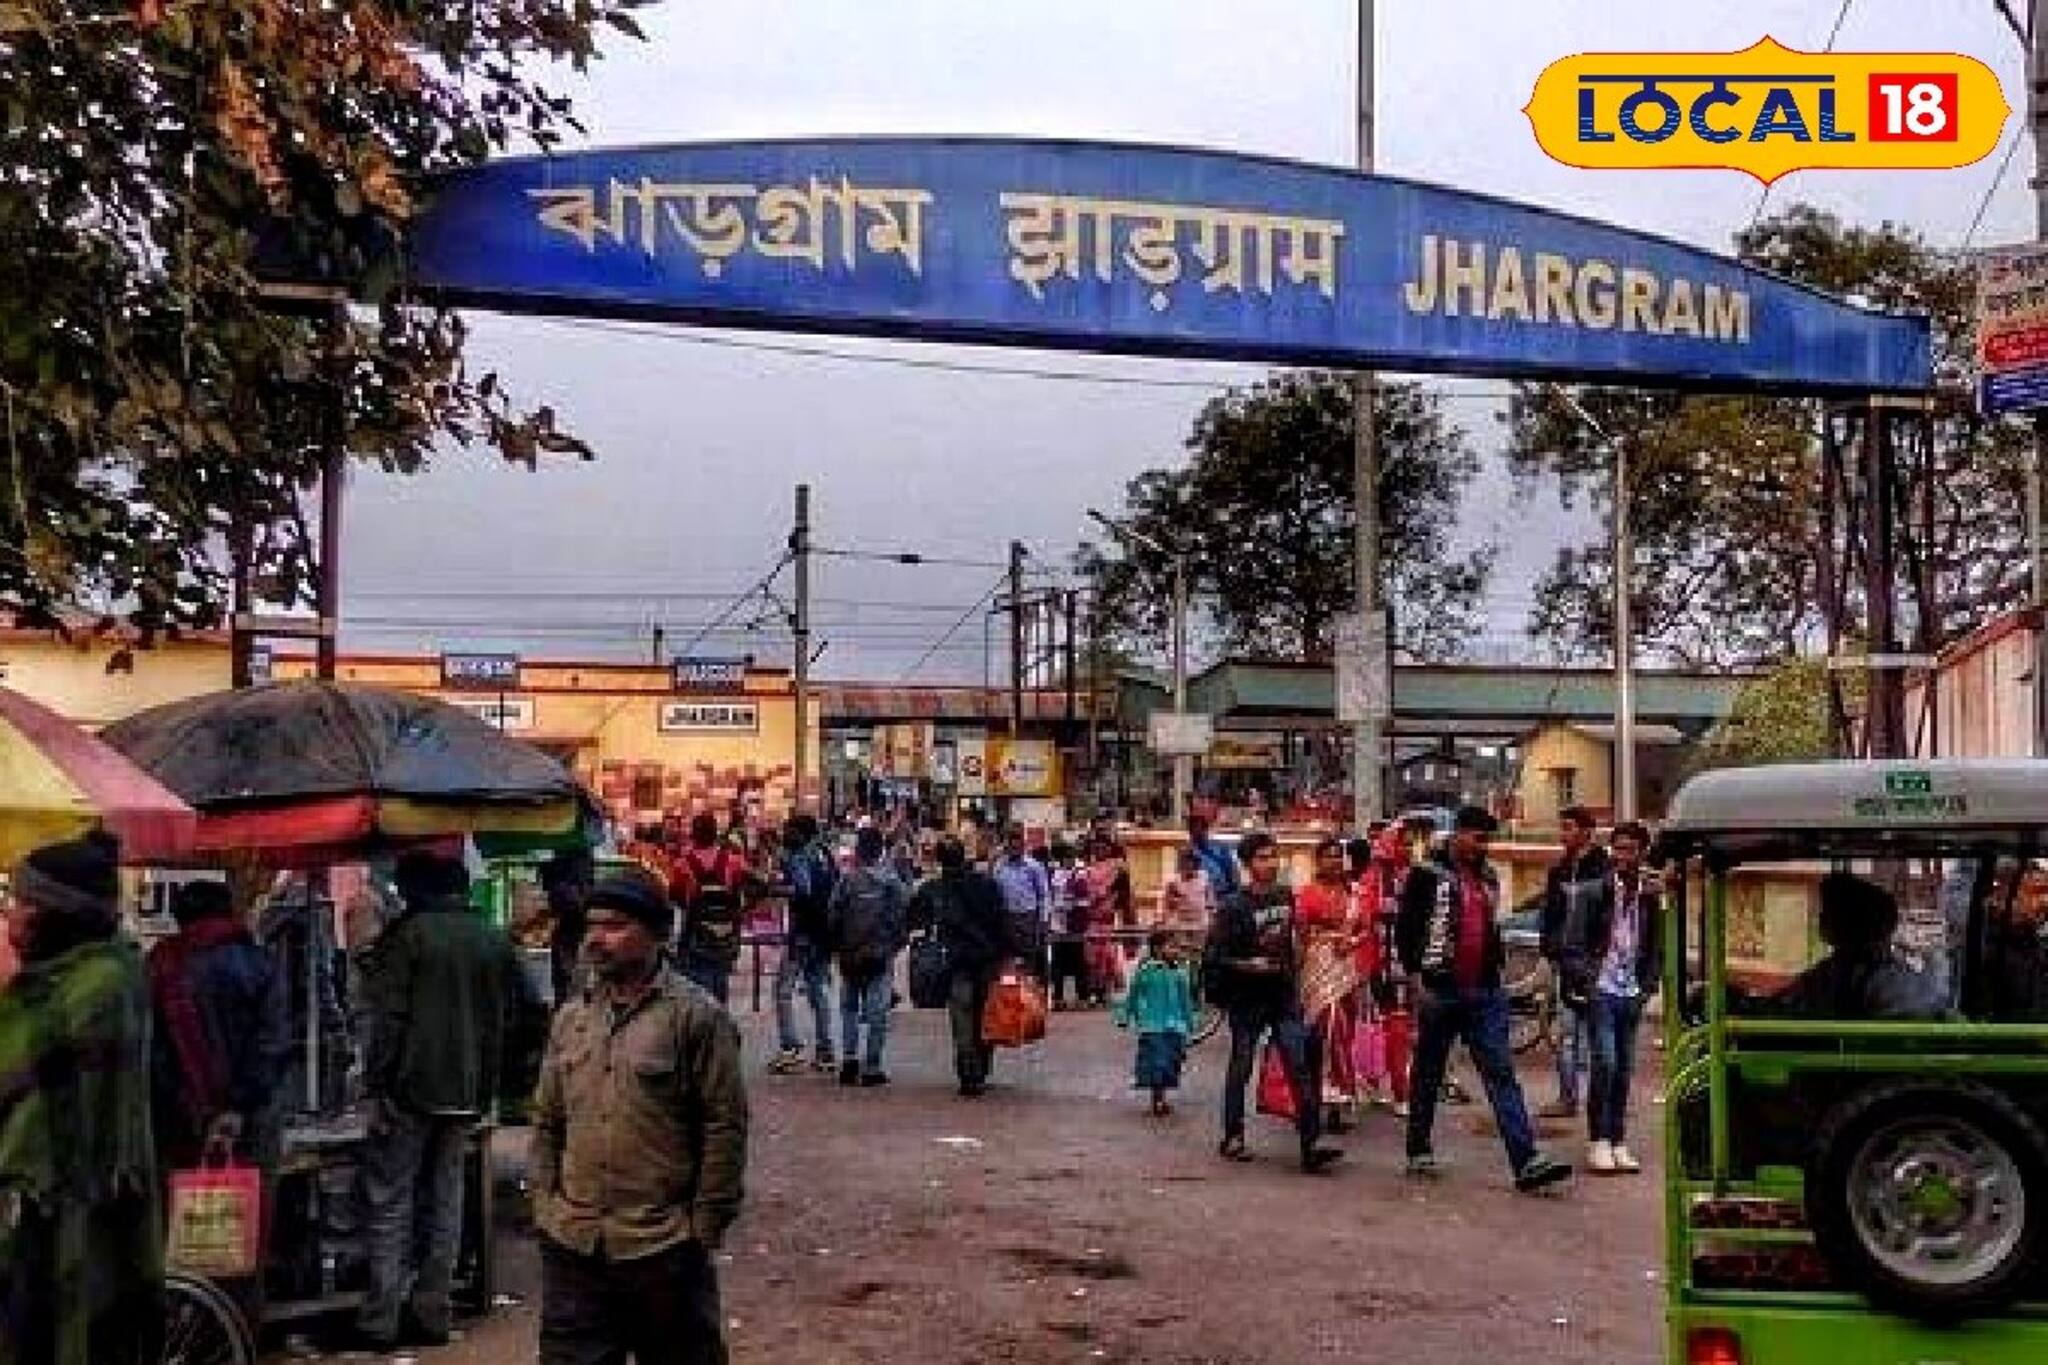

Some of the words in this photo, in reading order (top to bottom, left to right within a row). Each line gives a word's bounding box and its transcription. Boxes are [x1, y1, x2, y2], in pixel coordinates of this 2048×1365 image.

[523, 175, 934, 278] ঝাড়গ্রাম
[999, 192, 1344, 311] झाड़ग्राम
[1403, 235, 1749, 343] JHARGRAM
